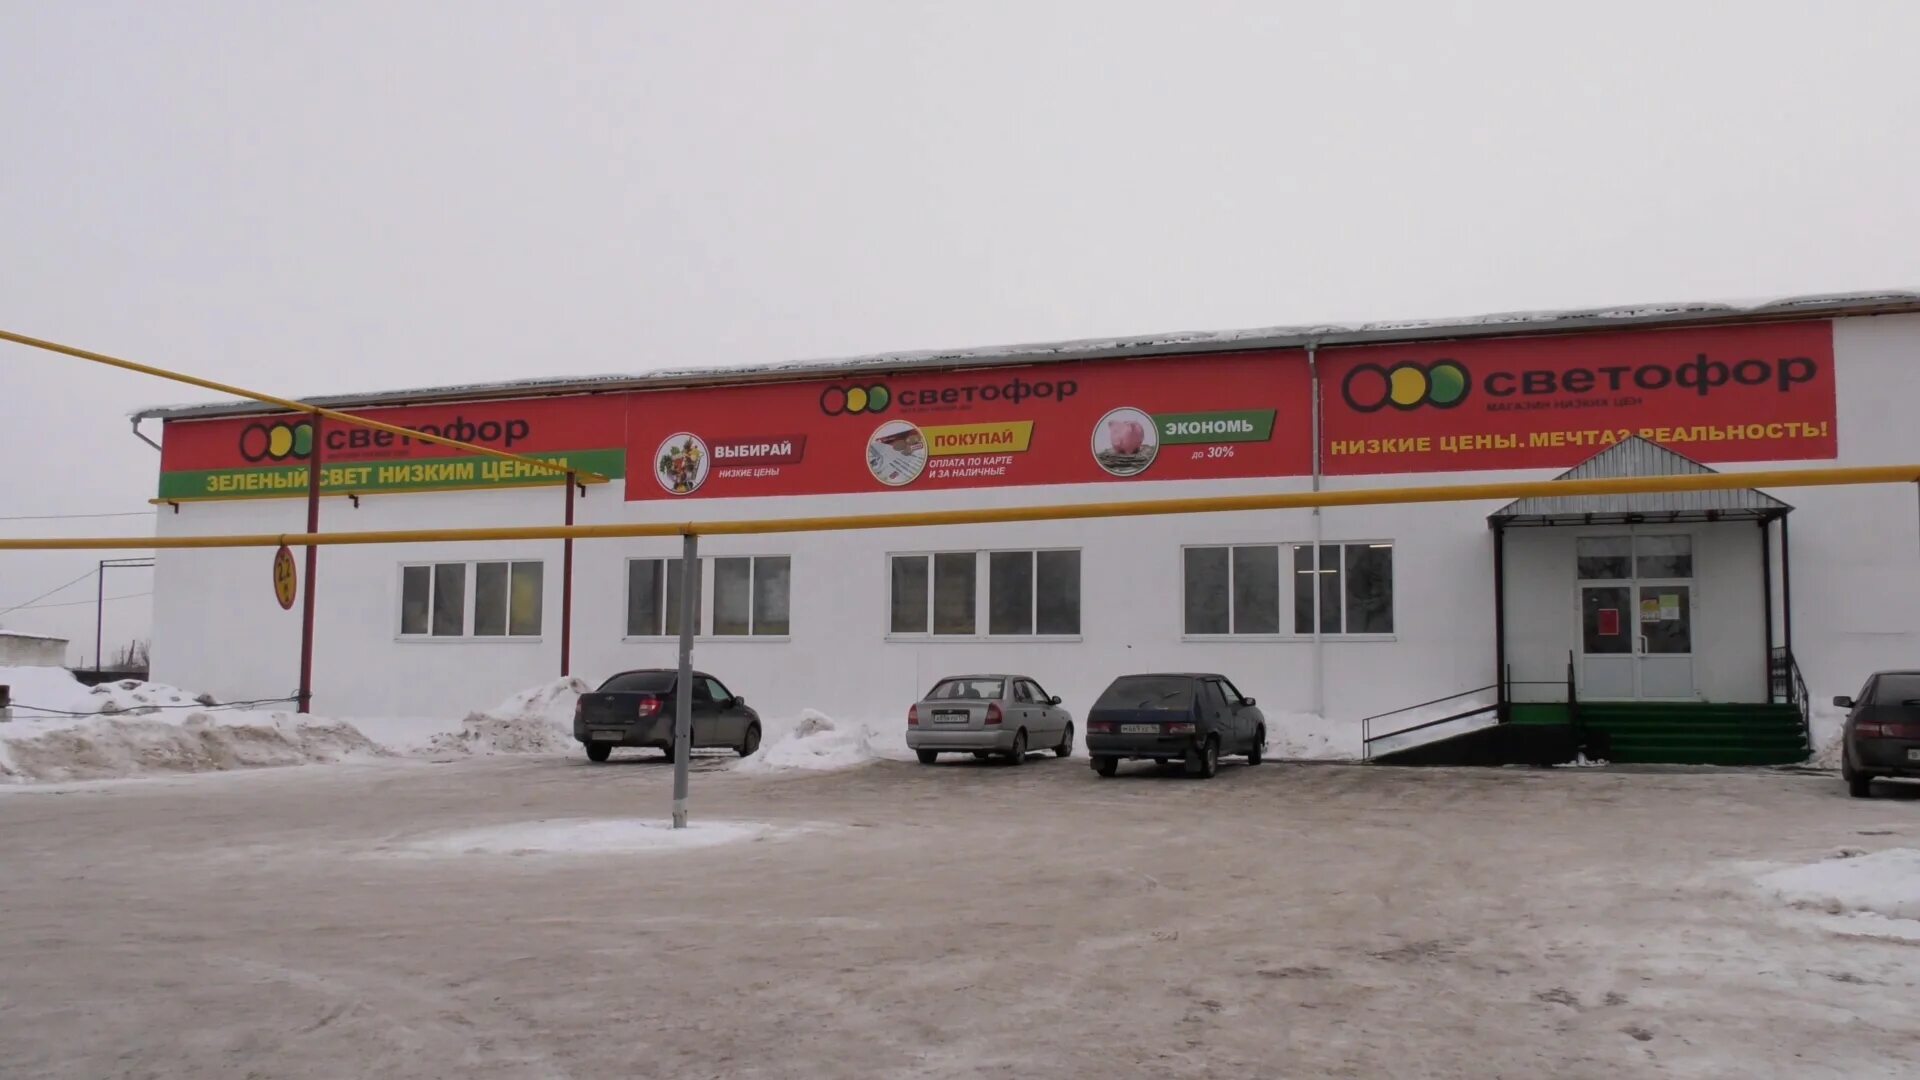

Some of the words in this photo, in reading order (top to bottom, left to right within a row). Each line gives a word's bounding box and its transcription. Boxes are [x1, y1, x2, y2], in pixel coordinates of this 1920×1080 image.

[1484, 353, 1818, 397] светофор
[898, 377, 1078, 404] светофор
[1165, 419, 1253, 436] ЭКОНОМЬ
[934, 429, 1014, 448] ПОКУПАЙ
[1331, 436, 1431, 456] НИЗКИЕ
[1440, 433, 1525, 453] ЦЕНЫ.
[1639, 422, 1827, 443] РЕАЛЬНОСТЬ!
[715, 440, 792, 458] ВЫБИРАЙ
[1207, 446, 1235, 459] 30%
[929, 458, 965, 468] ОПЛАТА
[967, 457, 981, 466] ПО
[983, 456, 1014, 465] КАРТЕ
[207, 467, 309, 492] ЗЕЛЕНЫЙ
[319, 467, 372, 487] СВЕТ
[378, 462, 475, 484] НИЗКИМ
[718, 468, 752, 478] НИЗКИЕ
[753, 468, 780, 478] ЦЕНЫ
[929, 470, 936, 479] И
[938, 469, 950, 478] ЗА
[952, 467, 1006, 477] НАЛИЧНЫЕ
